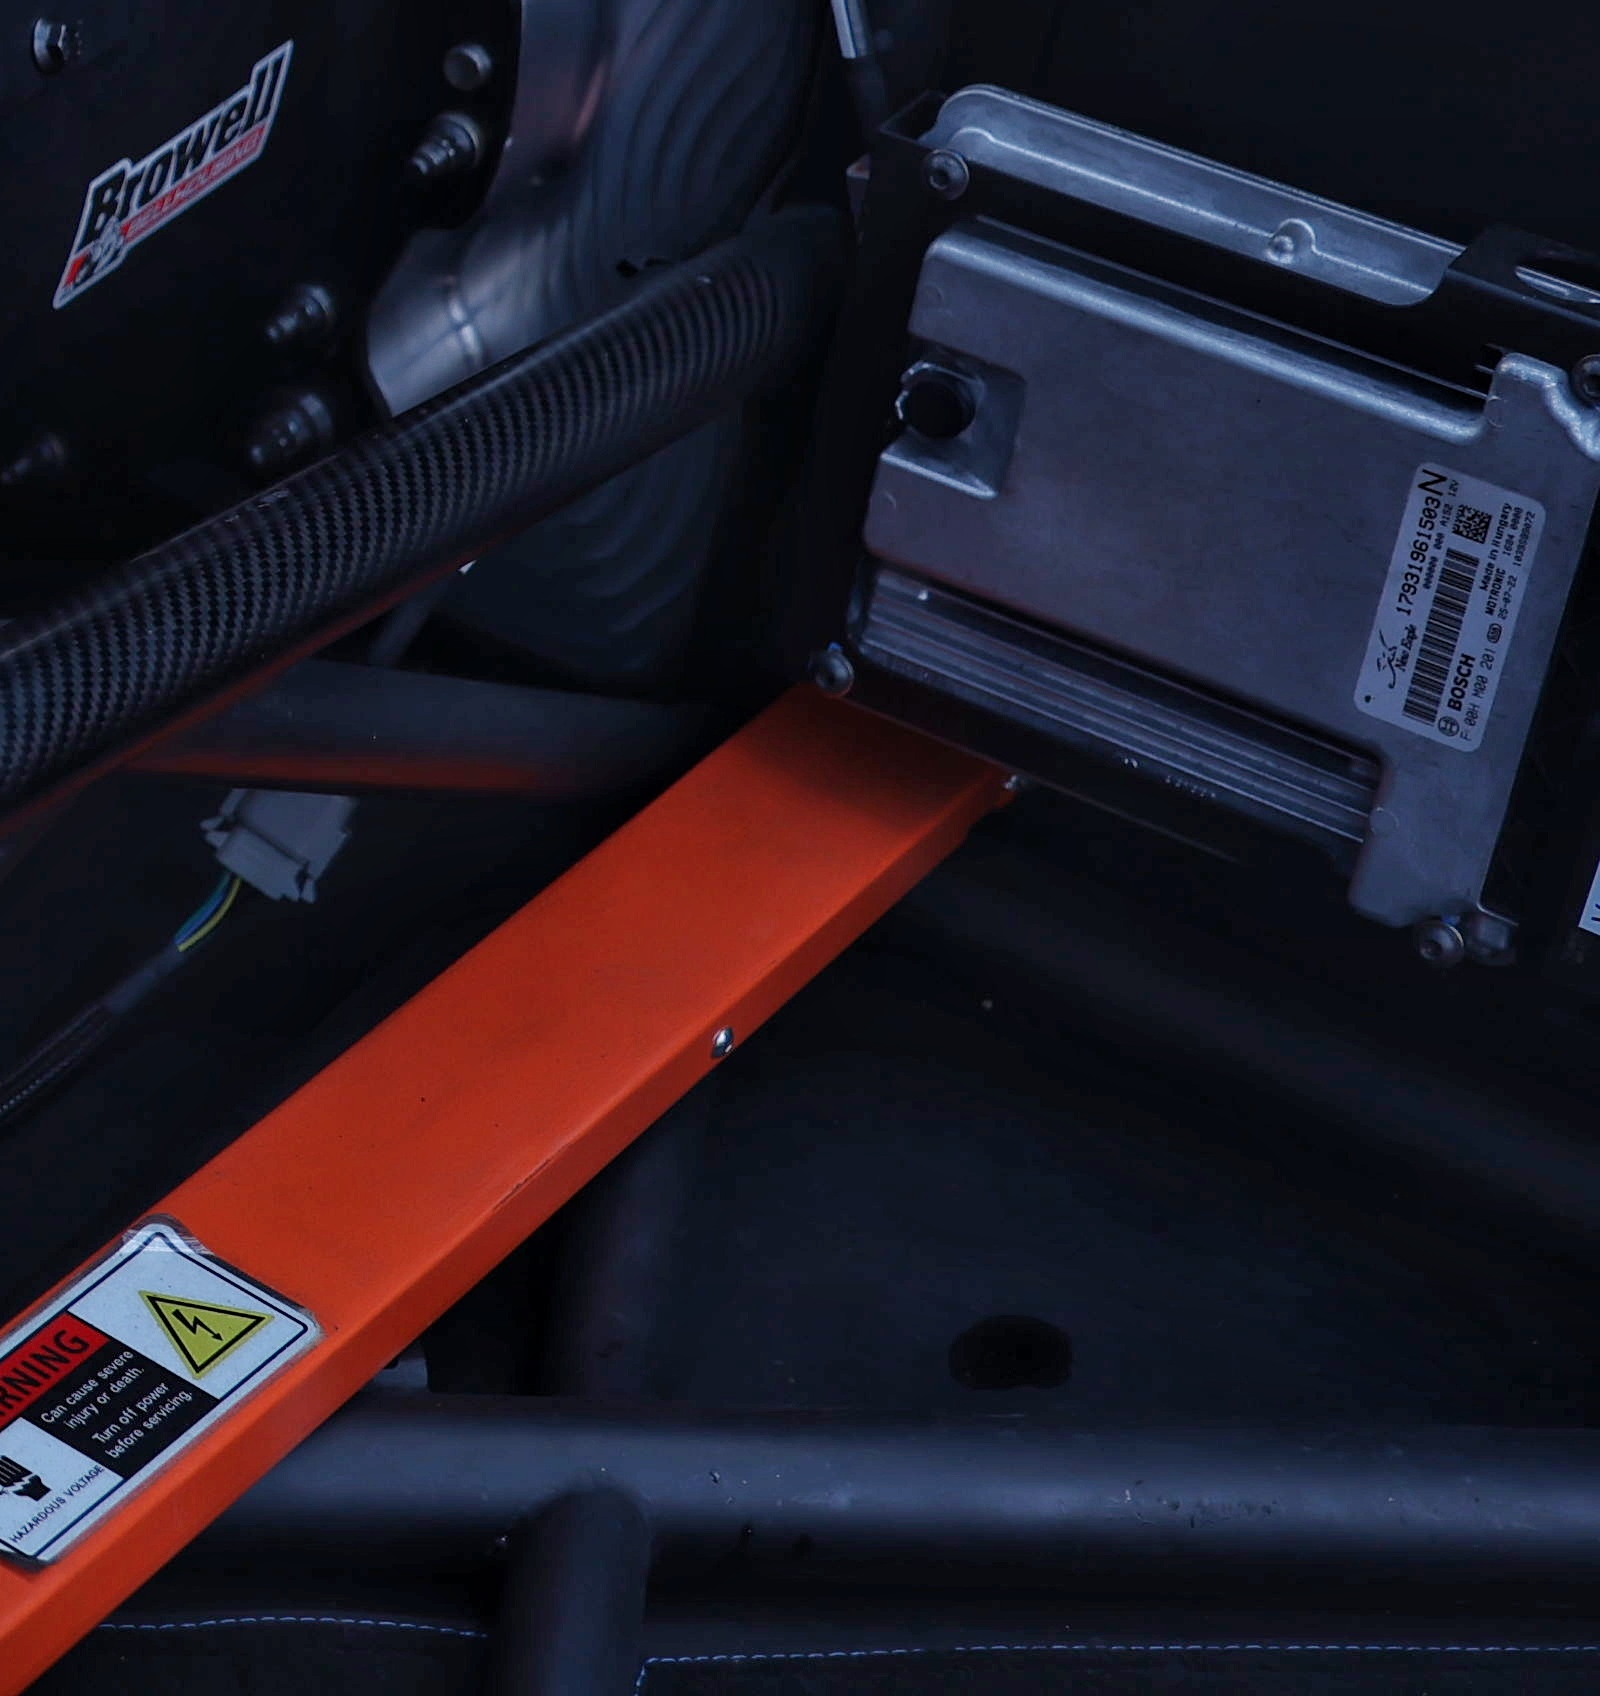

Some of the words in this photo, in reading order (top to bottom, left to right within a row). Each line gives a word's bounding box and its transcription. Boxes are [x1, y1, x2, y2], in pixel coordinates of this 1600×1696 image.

[73, 42, 291, 257] Browell
[1416, 467, 1449, 497] N
[1393, 495, 1443, 616] 17931961503
[1487, 547, 1499, 560] in
[1490, 501, 1514, 548] Hungary
[1478, 560, 1496, 591] Made
[1483, 566, 1506, 616] MOTRONIC
[1445, 652, 1476, 712] BOSCH
[1459, 730, 1473, 742] F
[1479, 646, 1497, 670] 201
[40, 1397, 69, 1426] Can
[65, 1375, 99, 1406] cause
[96, 1350, 134, 1386] severe
[65, 1401, 100, 1431] injury
[96, 1389, 113, 1406] or
[110, 1365, 145, 1397] death.
[91, 1417, 120, 1445] Turn
[118, 1405, 137, 1425] off
[134, 1381, 169, 1414] power
[104, 1428, 143, 1460] before
[141, 1389, 194, 1434] servicing.
[9, 1495, 67, 1544] HAZARDOUS
[63, 1465, 106, 1499] VOLTAGE
